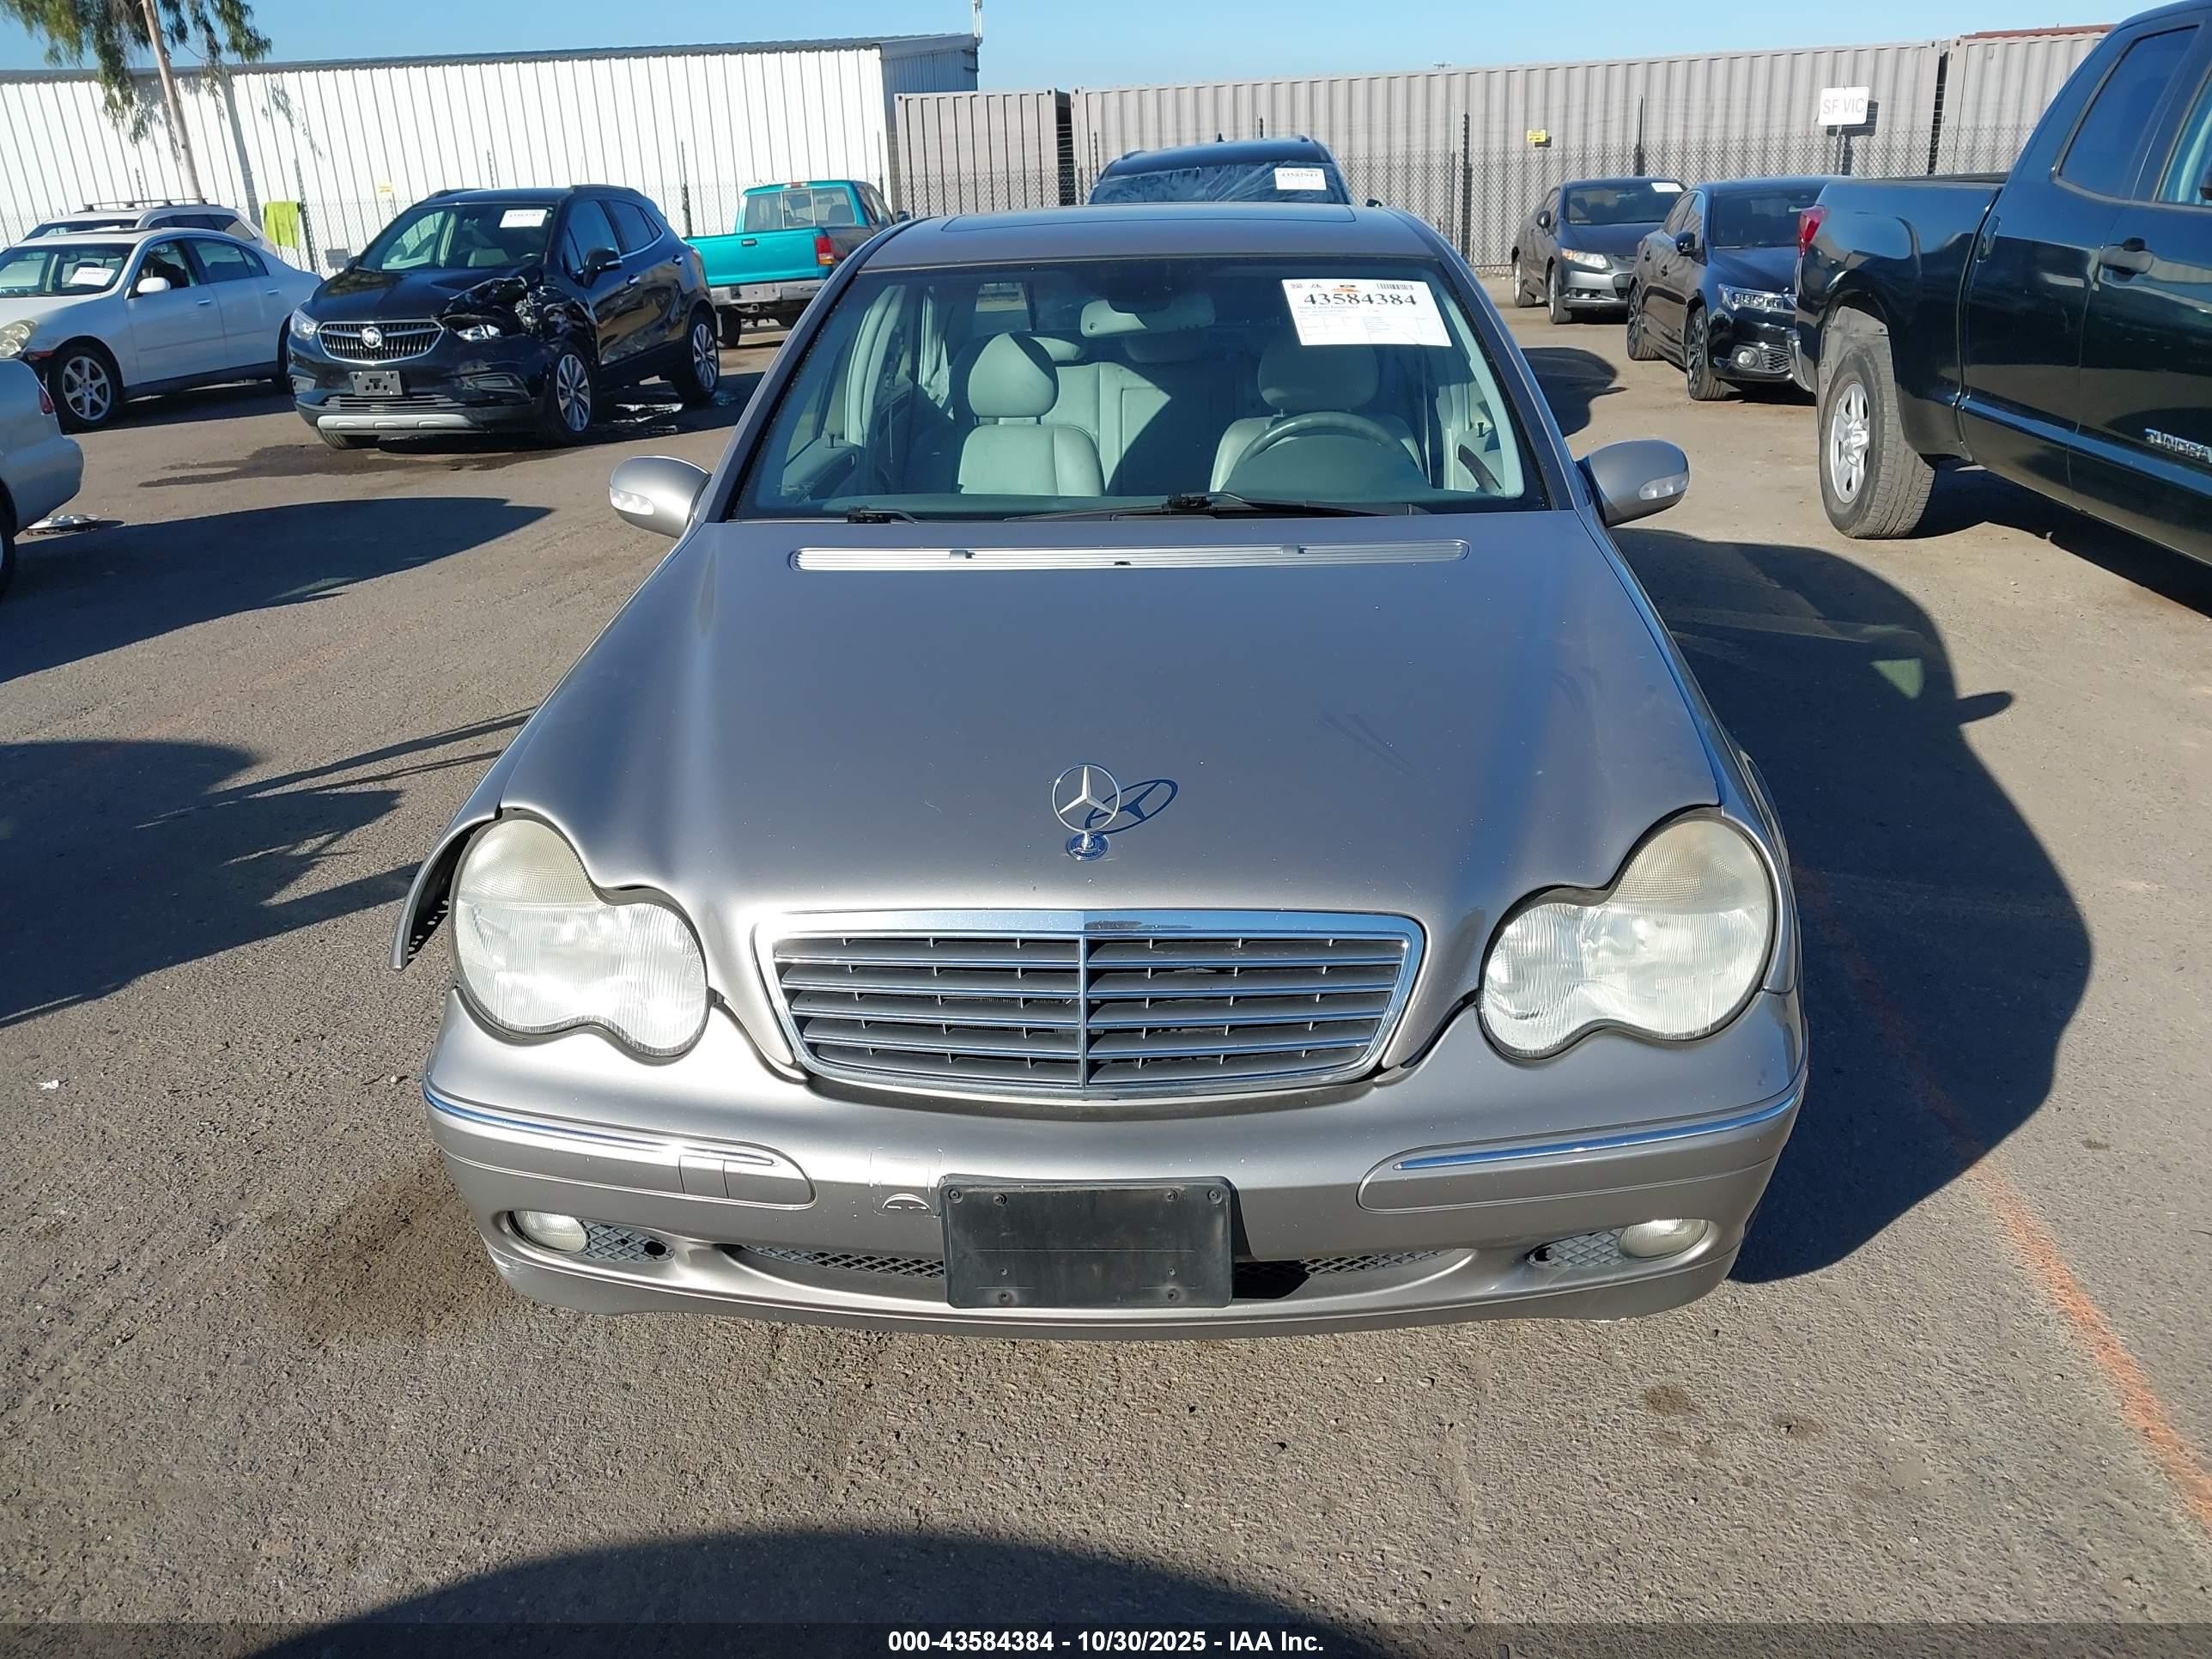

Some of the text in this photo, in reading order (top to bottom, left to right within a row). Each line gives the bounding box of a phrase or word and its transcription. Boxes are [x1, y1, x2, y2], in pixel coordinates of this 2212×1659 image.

[1822, 97, 1864, 115] SF VIC
[1304, 293, 1417, 306] 43584384
